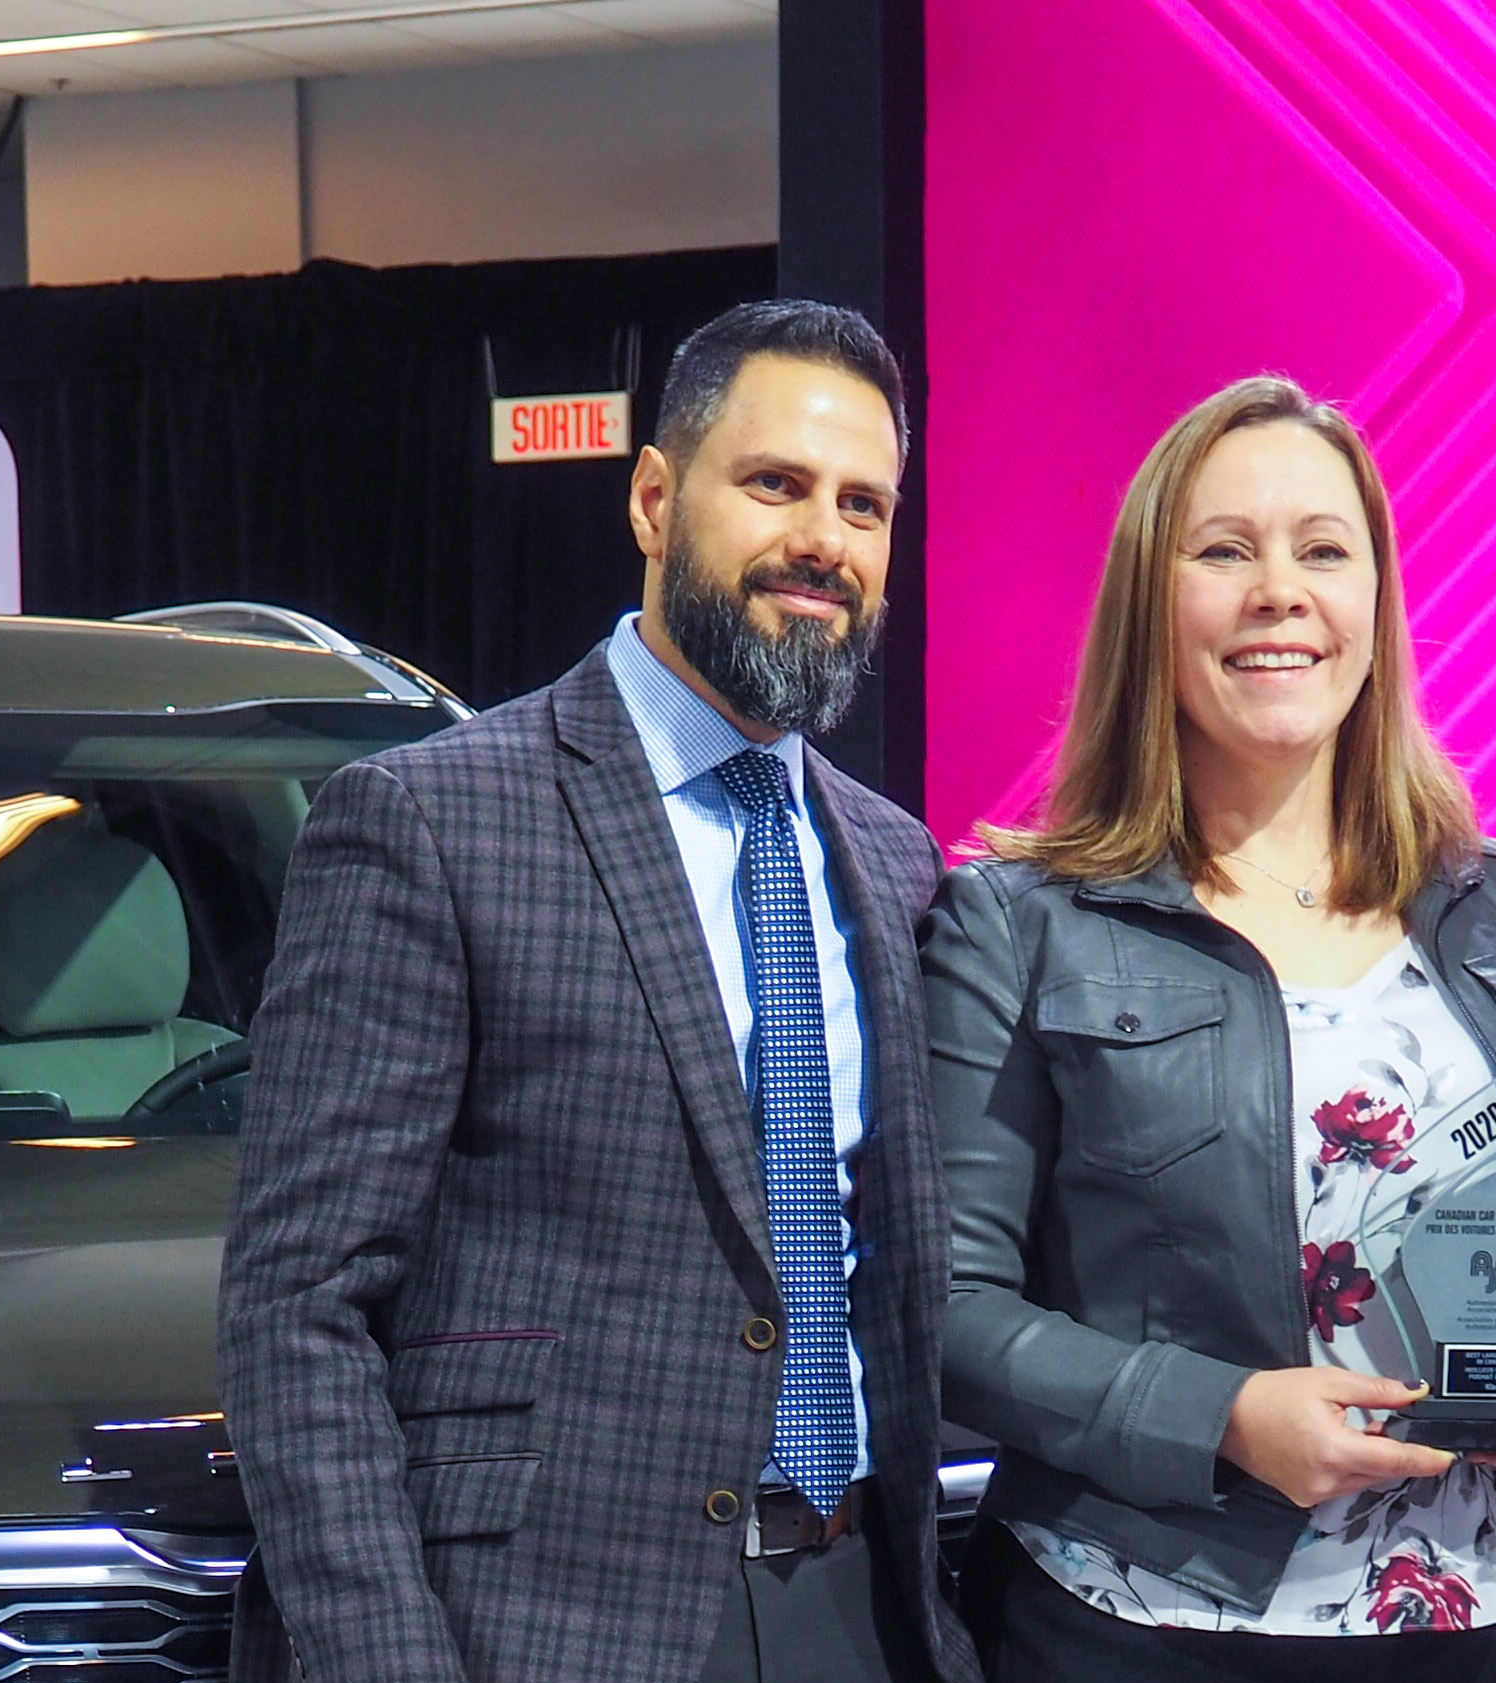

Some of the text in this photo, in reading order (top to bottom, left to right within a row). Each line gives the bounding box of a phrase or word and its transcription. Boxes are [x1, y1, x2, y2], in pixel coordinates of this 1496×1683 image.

[511, 401, 612, 453] SORTIE
[1435, 1209, 1476, 1221] CANADIAN
[1478, 1210, 1495, 1222] CAR
[1426, 1224, 1442, 1234] PRIX
[1445, 1224, 1458, 1235] DES
